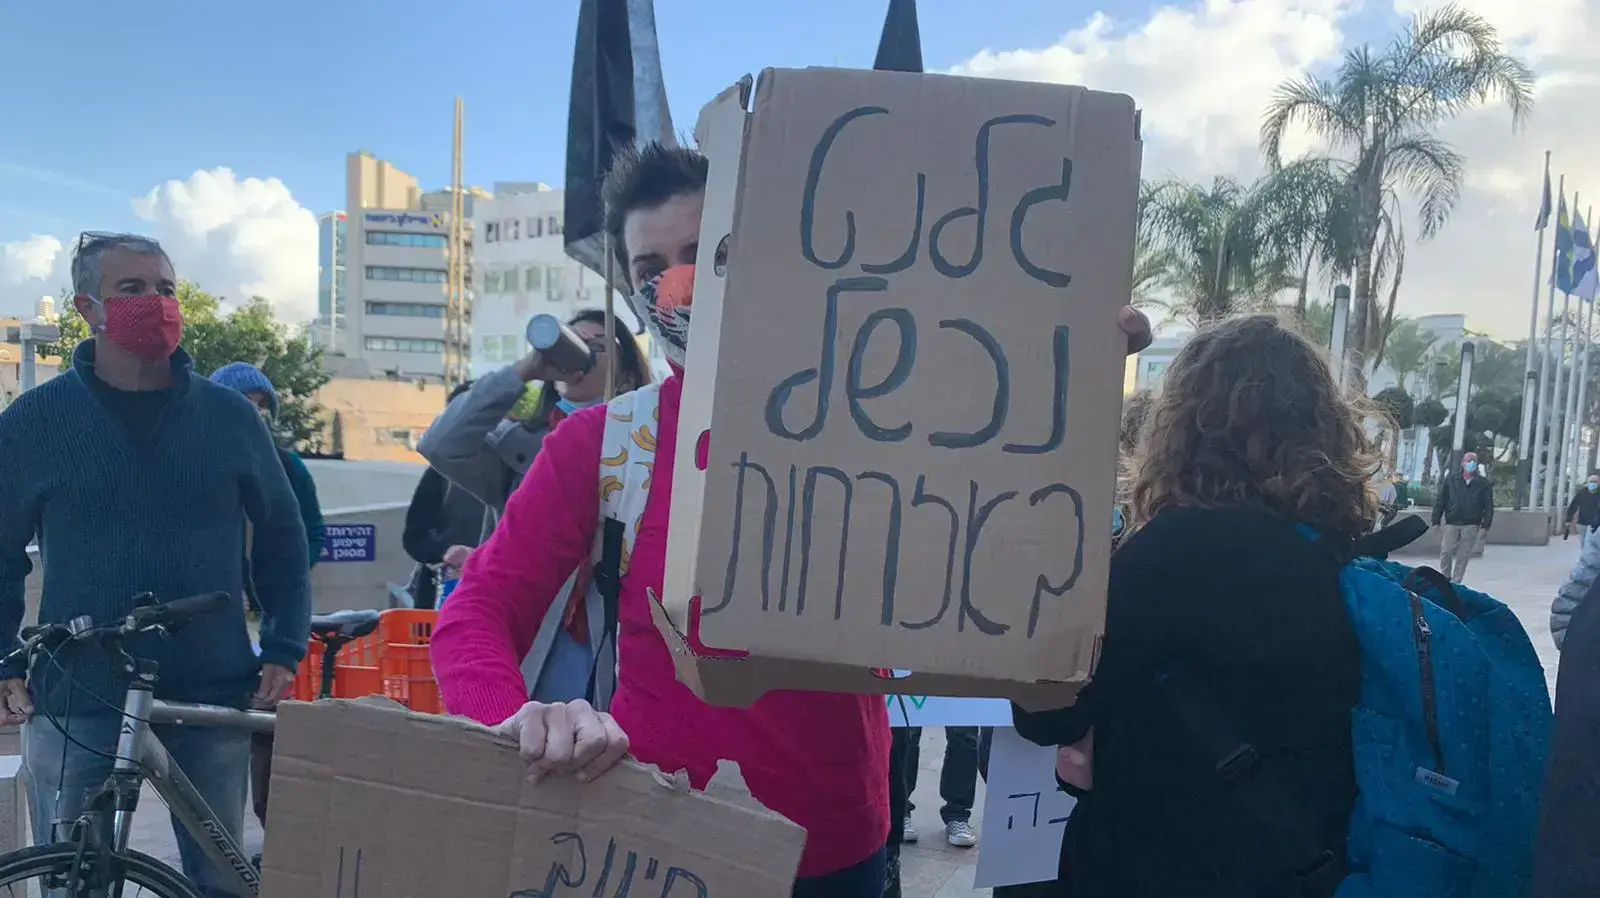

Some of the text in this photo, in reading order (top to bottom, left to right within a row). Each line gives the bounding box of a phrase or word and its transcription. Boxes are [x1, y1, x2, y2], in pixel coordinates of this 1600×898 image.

[800, 105, 1073, 288] גלנט
[764, 276, 1070, 454] נכשל
[332, 538, 367, 548] שיפוע
[333, 548, 366, 560] מסוכן
